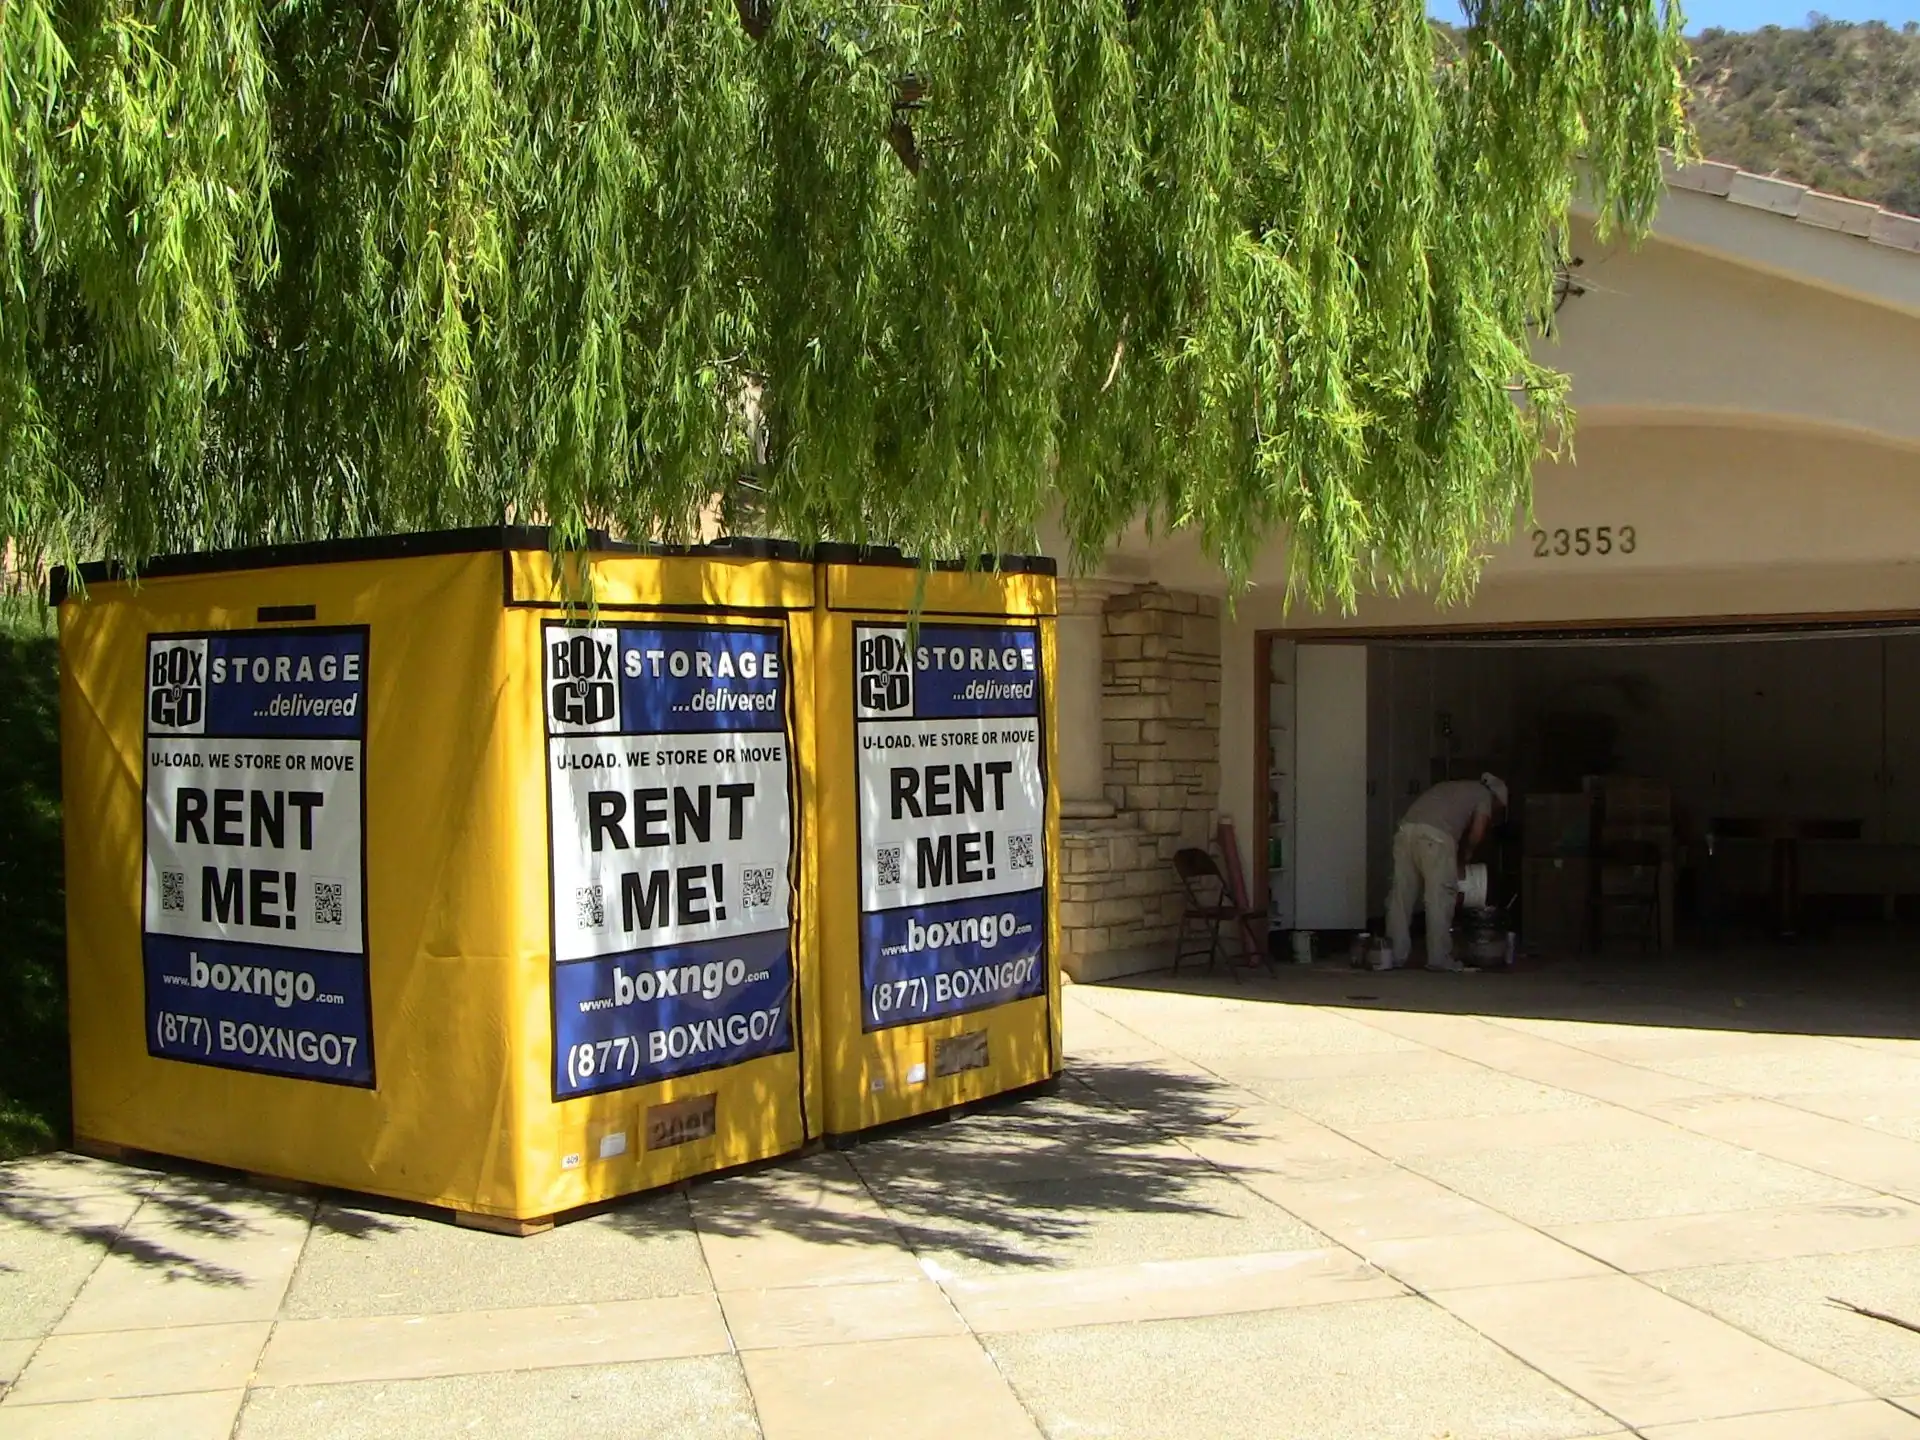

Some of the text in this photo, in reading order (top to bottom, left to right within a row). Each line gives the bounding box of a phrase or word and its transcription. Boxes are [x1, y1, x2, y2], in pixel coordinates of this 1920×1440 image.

[1531, 524, 1637, 558] 23553
[153, 646, 203, 687] BOX
[211, 654, 360, 684] STORAGE
[551, 635, 613, 680] BOX
[624, 650, 779, 679] STORAGE
[860, 634, 909, 673] BOX
[916, 647, 1036, 671] STORAGE
[151, 688, 202, 727] GO
[253, 692, 358, 717] ...delivered
[552, 682, 615, 726] GO
[672, 688, 777, 712] ...delivered
[860, 673, 910, 711] GO
[953, 679, 1034, 700] ...delivered
[557, 747, 782, 770] U-LOAD. WE STORE OR MOVE
[863, 730, 1035, 749] U-LOAD. WE STORE OR MOVE
[151, 752, 354, 771] U-LOAD. WE STORE OR MOVE
[890, 761, 1012, 820] RENT
[175, 787, 324, 850] RENT
[588, 783, 755, 852] RENT
[917, 830, 996, 889] ME!
[202, 866, 297, 930] ME!
[621, 863, 727, 932] ME!
[162, 952, 345, 1008] www.boxngo.com
[579, 958, 770, 1013] www.boxngo.com
[871, 956, 1036, 1021] (877) BOXNGO7
[157, 1011, 358, 1068] (877) BOXNGO7
[567, 1007, 781, 1088] (877) BOXNGO7
